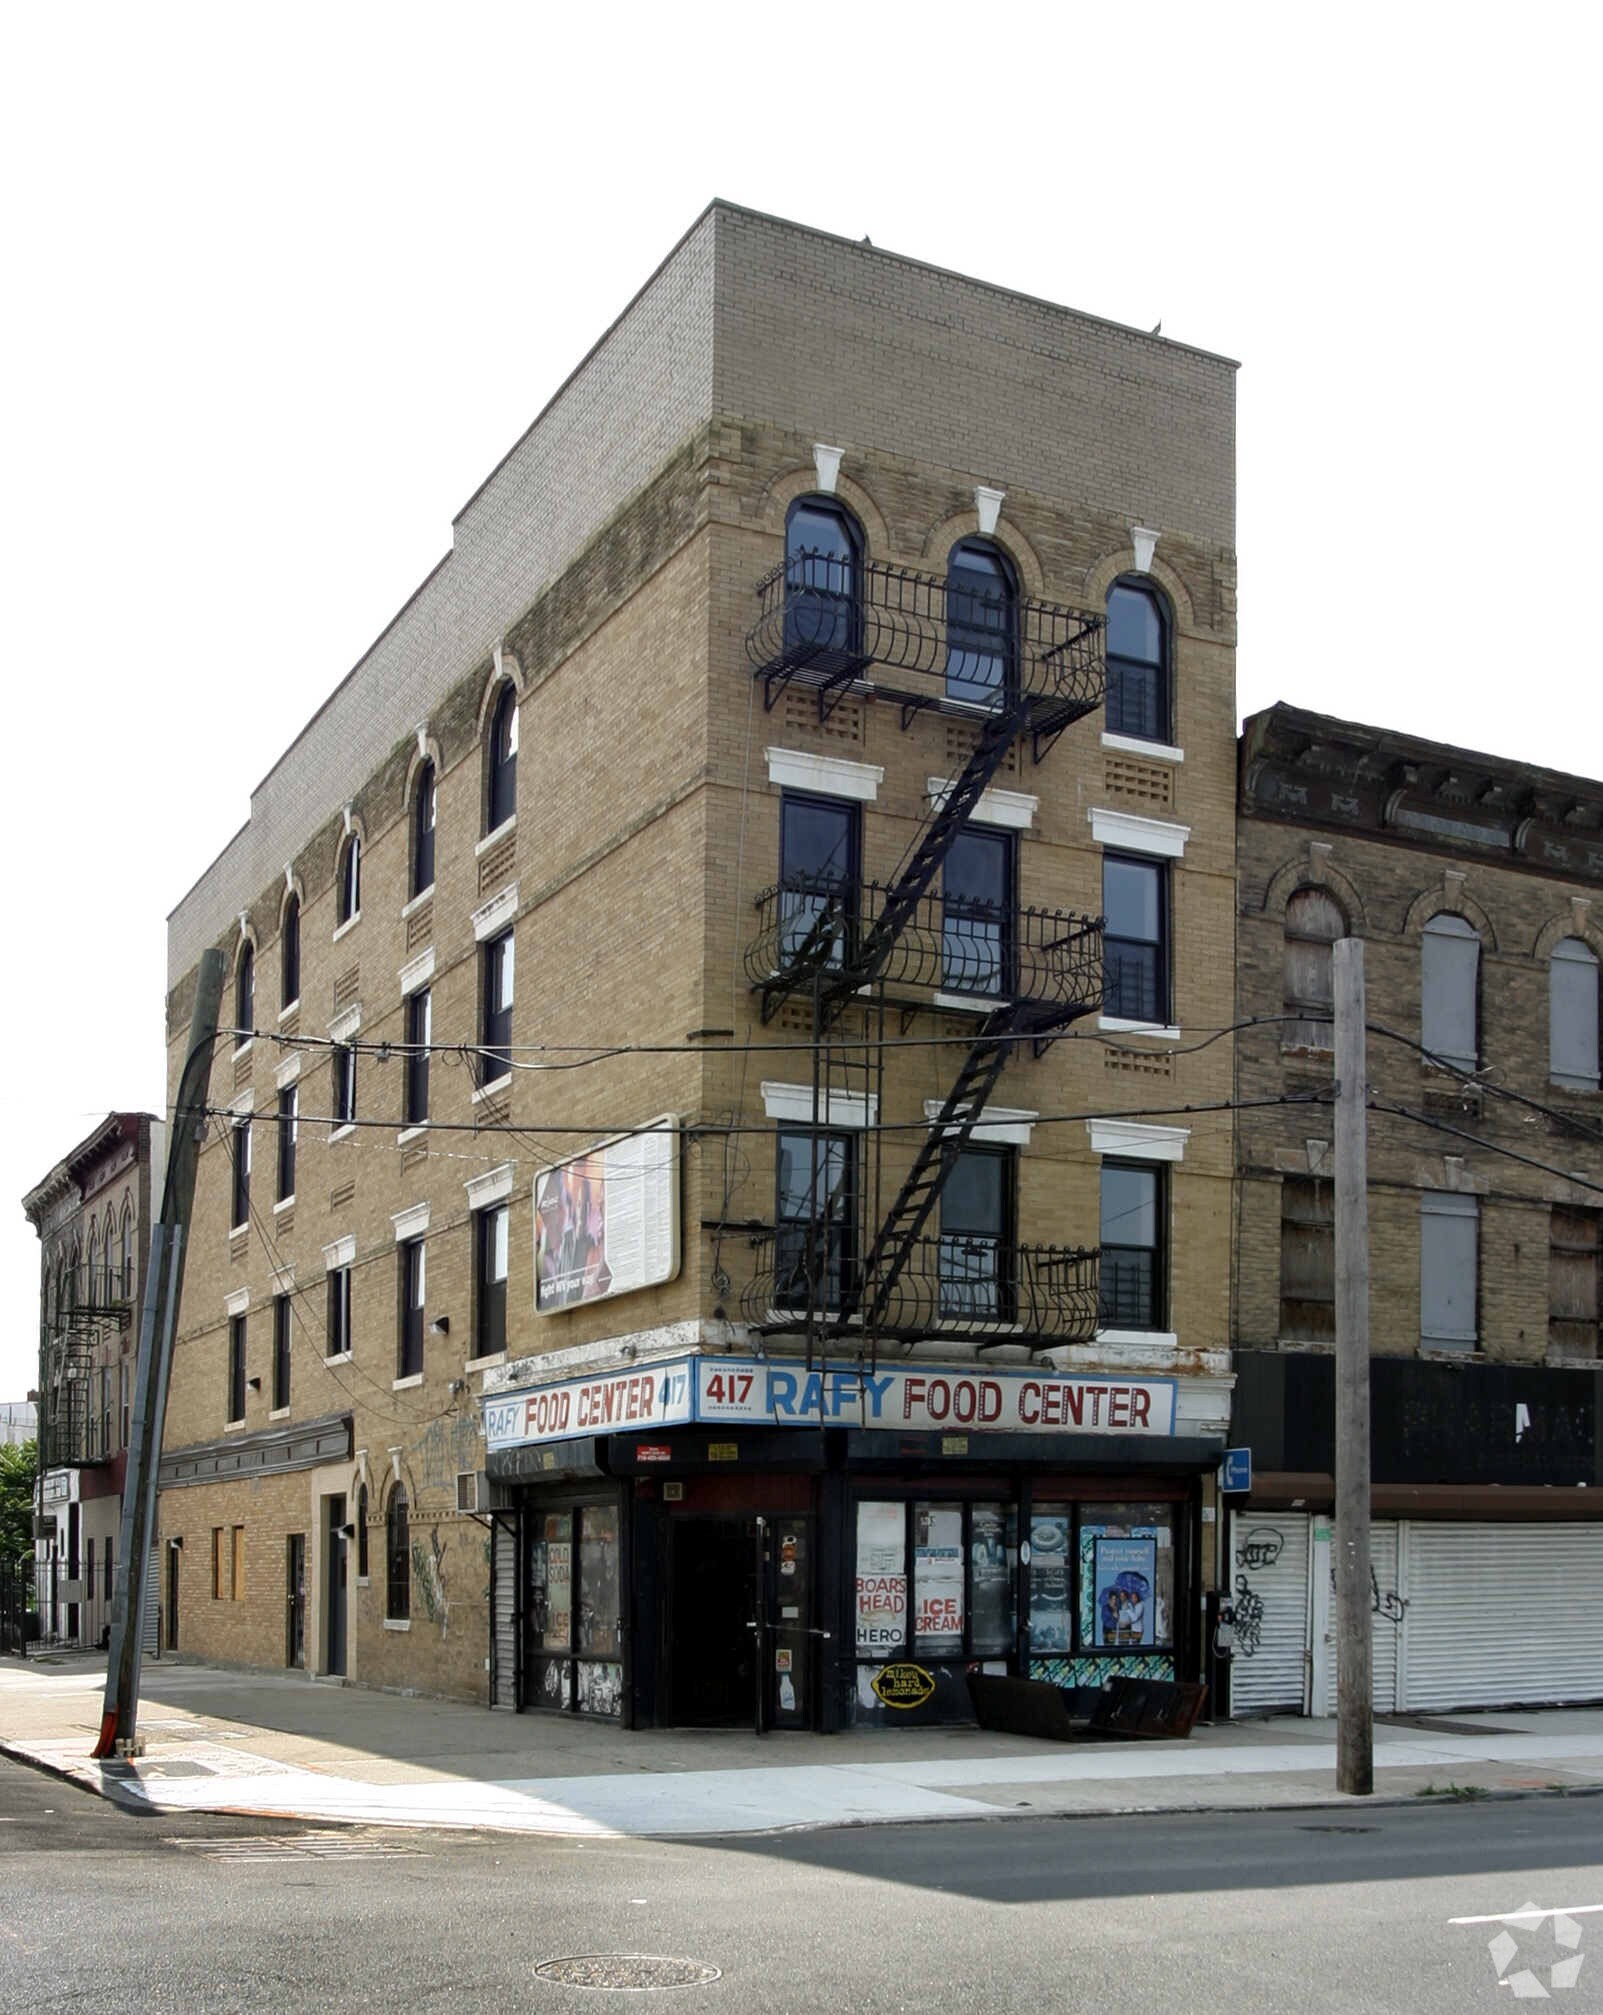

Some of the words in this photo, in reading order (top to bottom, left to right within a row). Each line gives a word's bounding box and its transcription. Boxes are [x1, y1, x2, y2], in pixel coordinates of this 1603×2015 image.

[488, 1405, 520, 1437] RAFY
[525, 1391, 571, 1435] FOOD
[577, 1376, 655, 1426] CENTER
[660, 1374, 686, 1405] 417
[706, 1374, 754, 1403] 417
[766, 1371, 895, 1418] RAFY
[903, 1378, 1003, 1423] FOOD
[1018, 1382, 1151, 1428] CENTER
[856, 1577, 905, 1594] BOARS
[860, 1595, 904, 1614] HEAD
[923, 1598, 957, 1615] ICE
[915, 1615, 964, 1633] CREAM
[857, 1628, 903, 1643] HERO
[894, 1678, 920, 1688] hard
